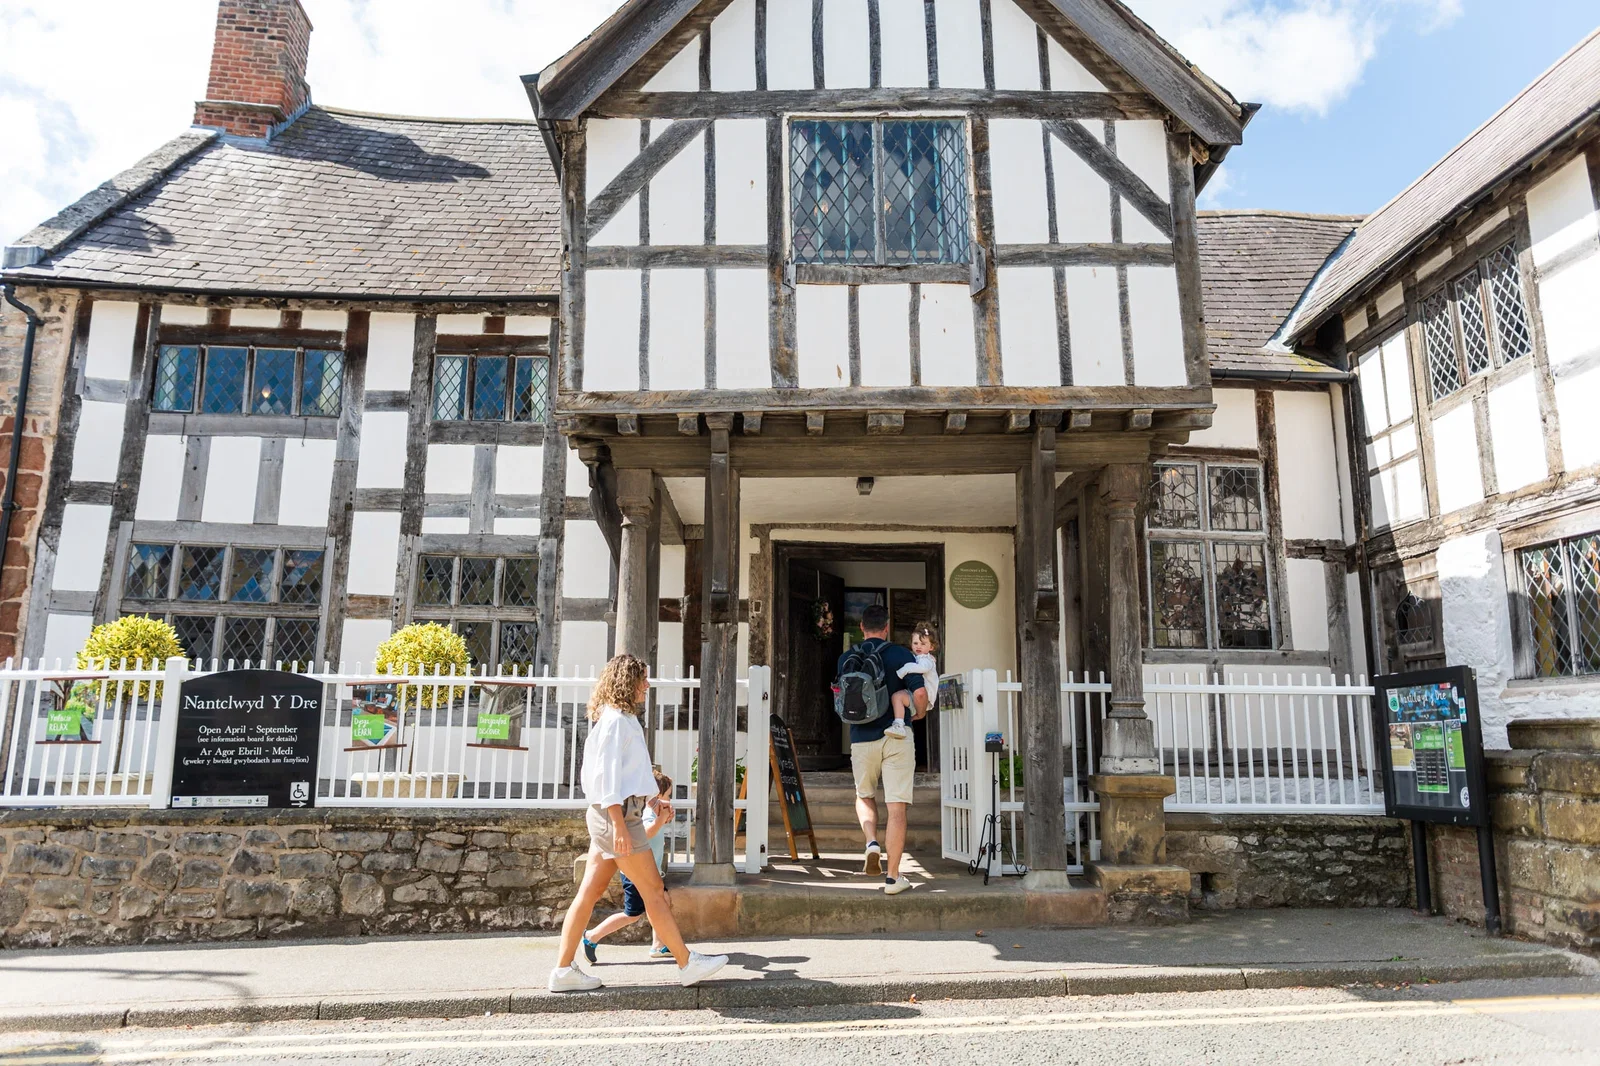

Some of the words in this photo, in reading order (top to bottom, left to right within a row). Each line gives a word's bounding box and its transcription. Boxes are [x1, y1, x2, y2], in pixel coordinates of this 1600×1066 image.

[1435, 690, 1446, 700] Dre
[184, 695, 264, 713] Nantclwyd
[272, 695, 285, 709] Y
[290, 695, 317, 709] Dre
[199, 725, 221, 735] Open
[225, 725, 246, 735] April
[256, 725, 298, 735] September
[354, 728, 372, 736] LEARN
[215, 748, 235, 757] Agor
[239, 747, 262, 755] Ebrill
[272, 747, 293, 755] Medi
[183, 757, 204, 765] (gweler
[284, 756, 309, 764] fanylion)
